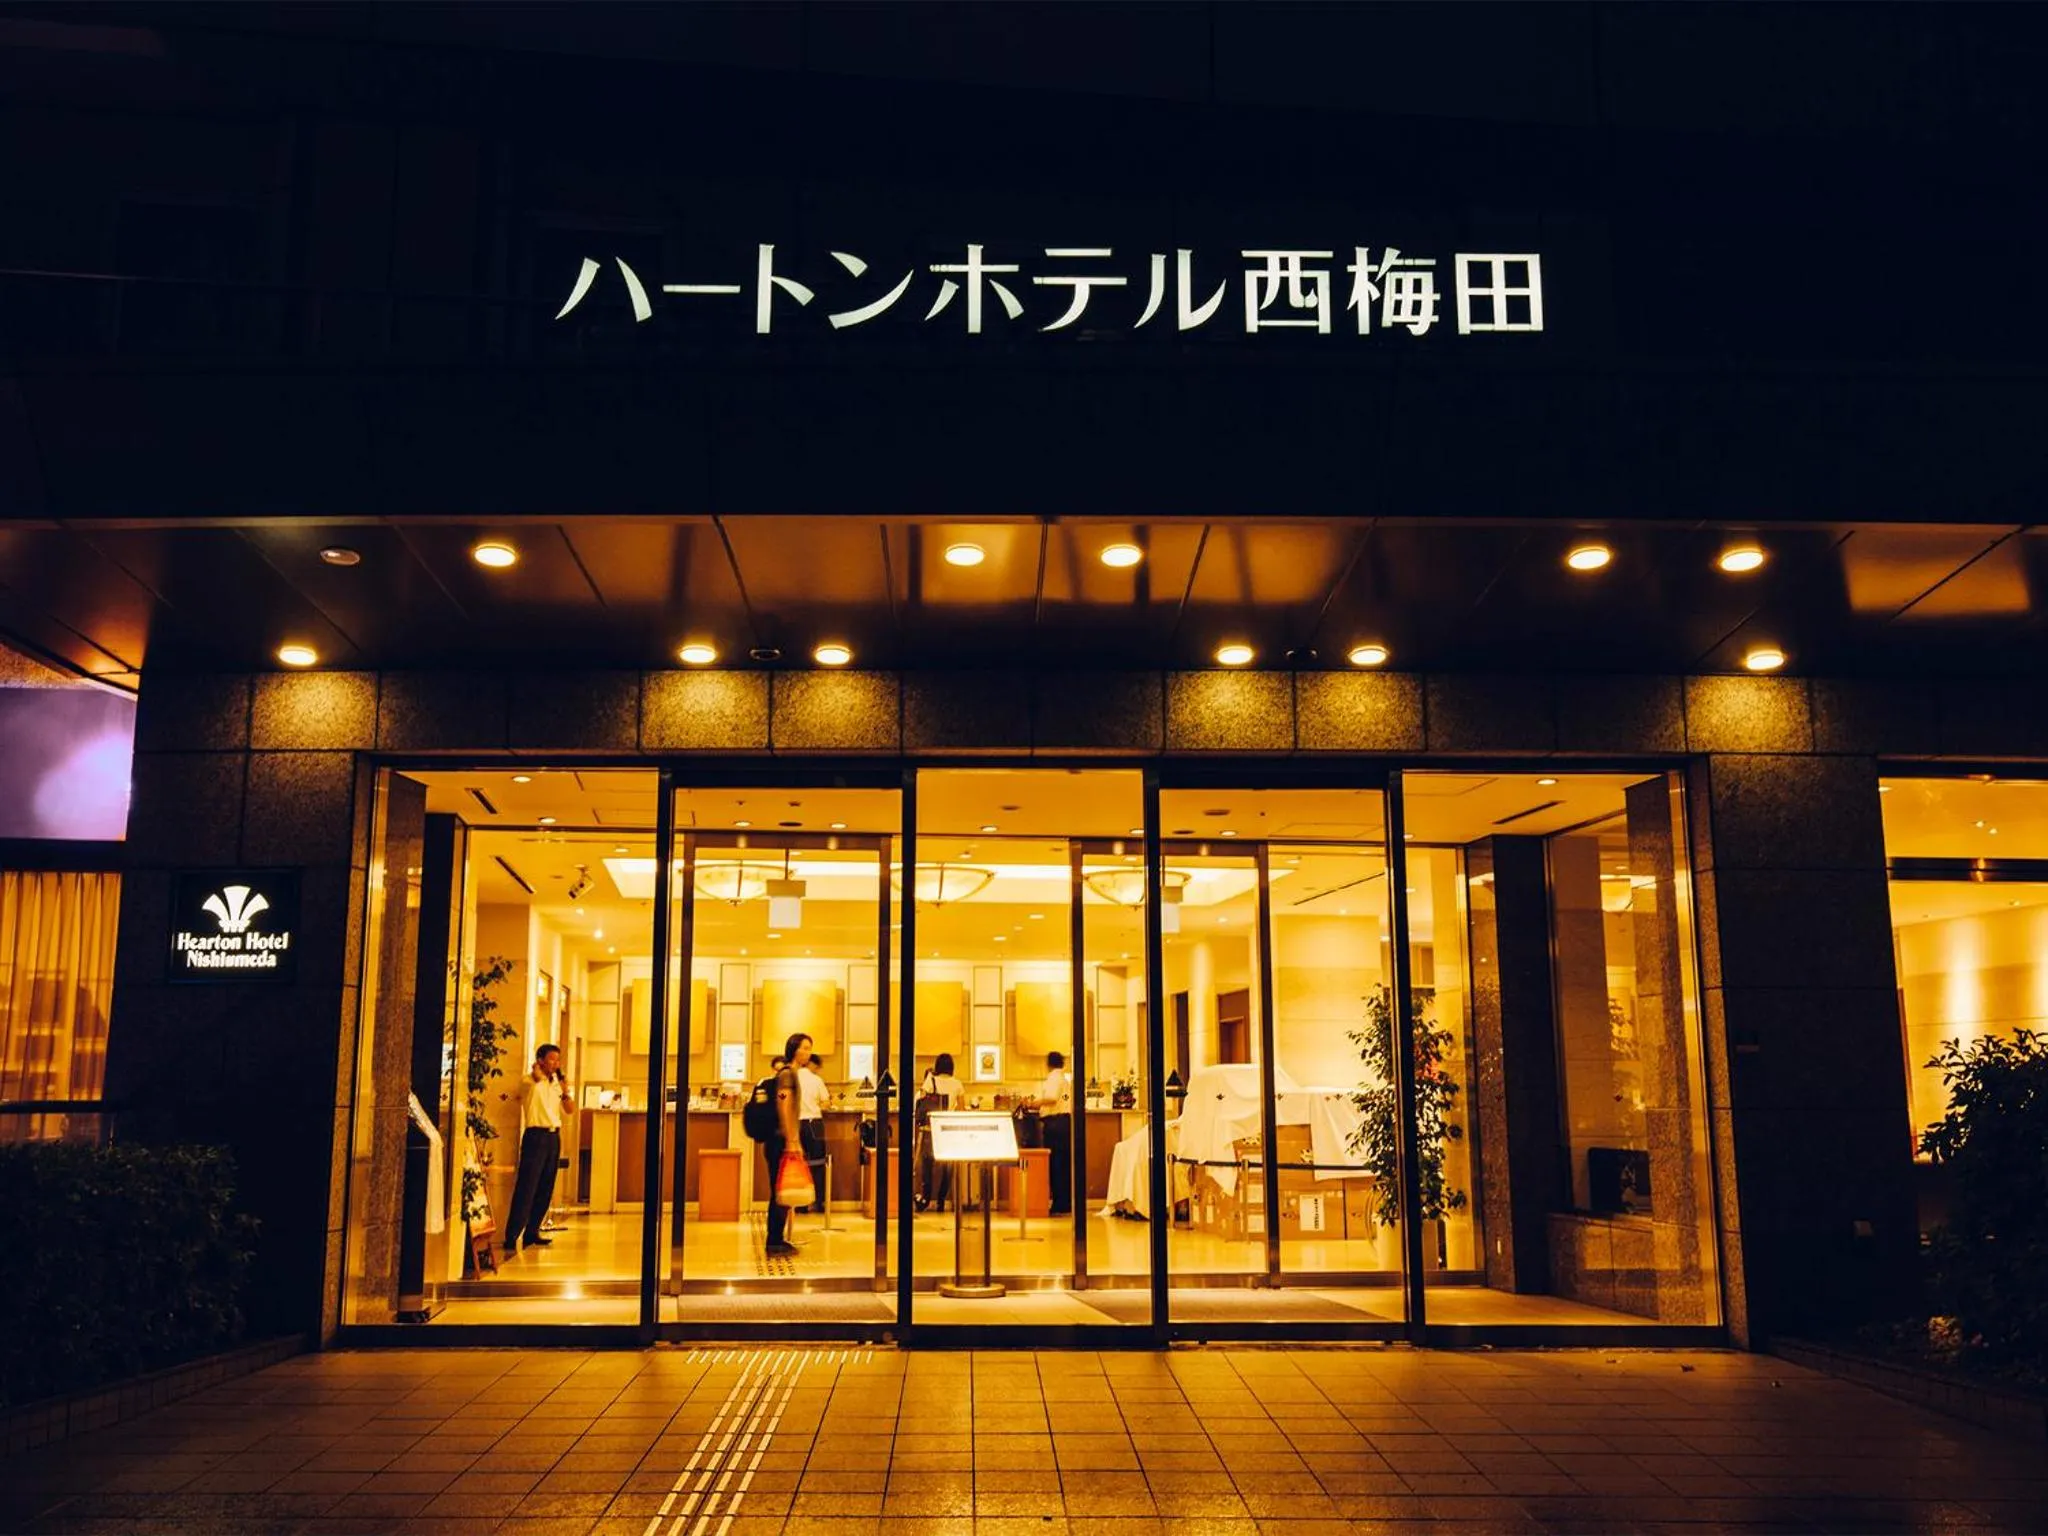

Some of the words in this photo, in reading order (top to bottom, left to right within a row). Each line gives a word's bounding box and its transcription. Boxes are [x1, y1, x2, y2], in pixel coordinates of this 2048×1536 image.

[555, 243, 1544, 336] ハートンホテル西梅田
[176, 931, 241, 951] Hearton
[245, 931, 290, 951] Hotel
[186, 949, 278, 968] Nishiumeda
